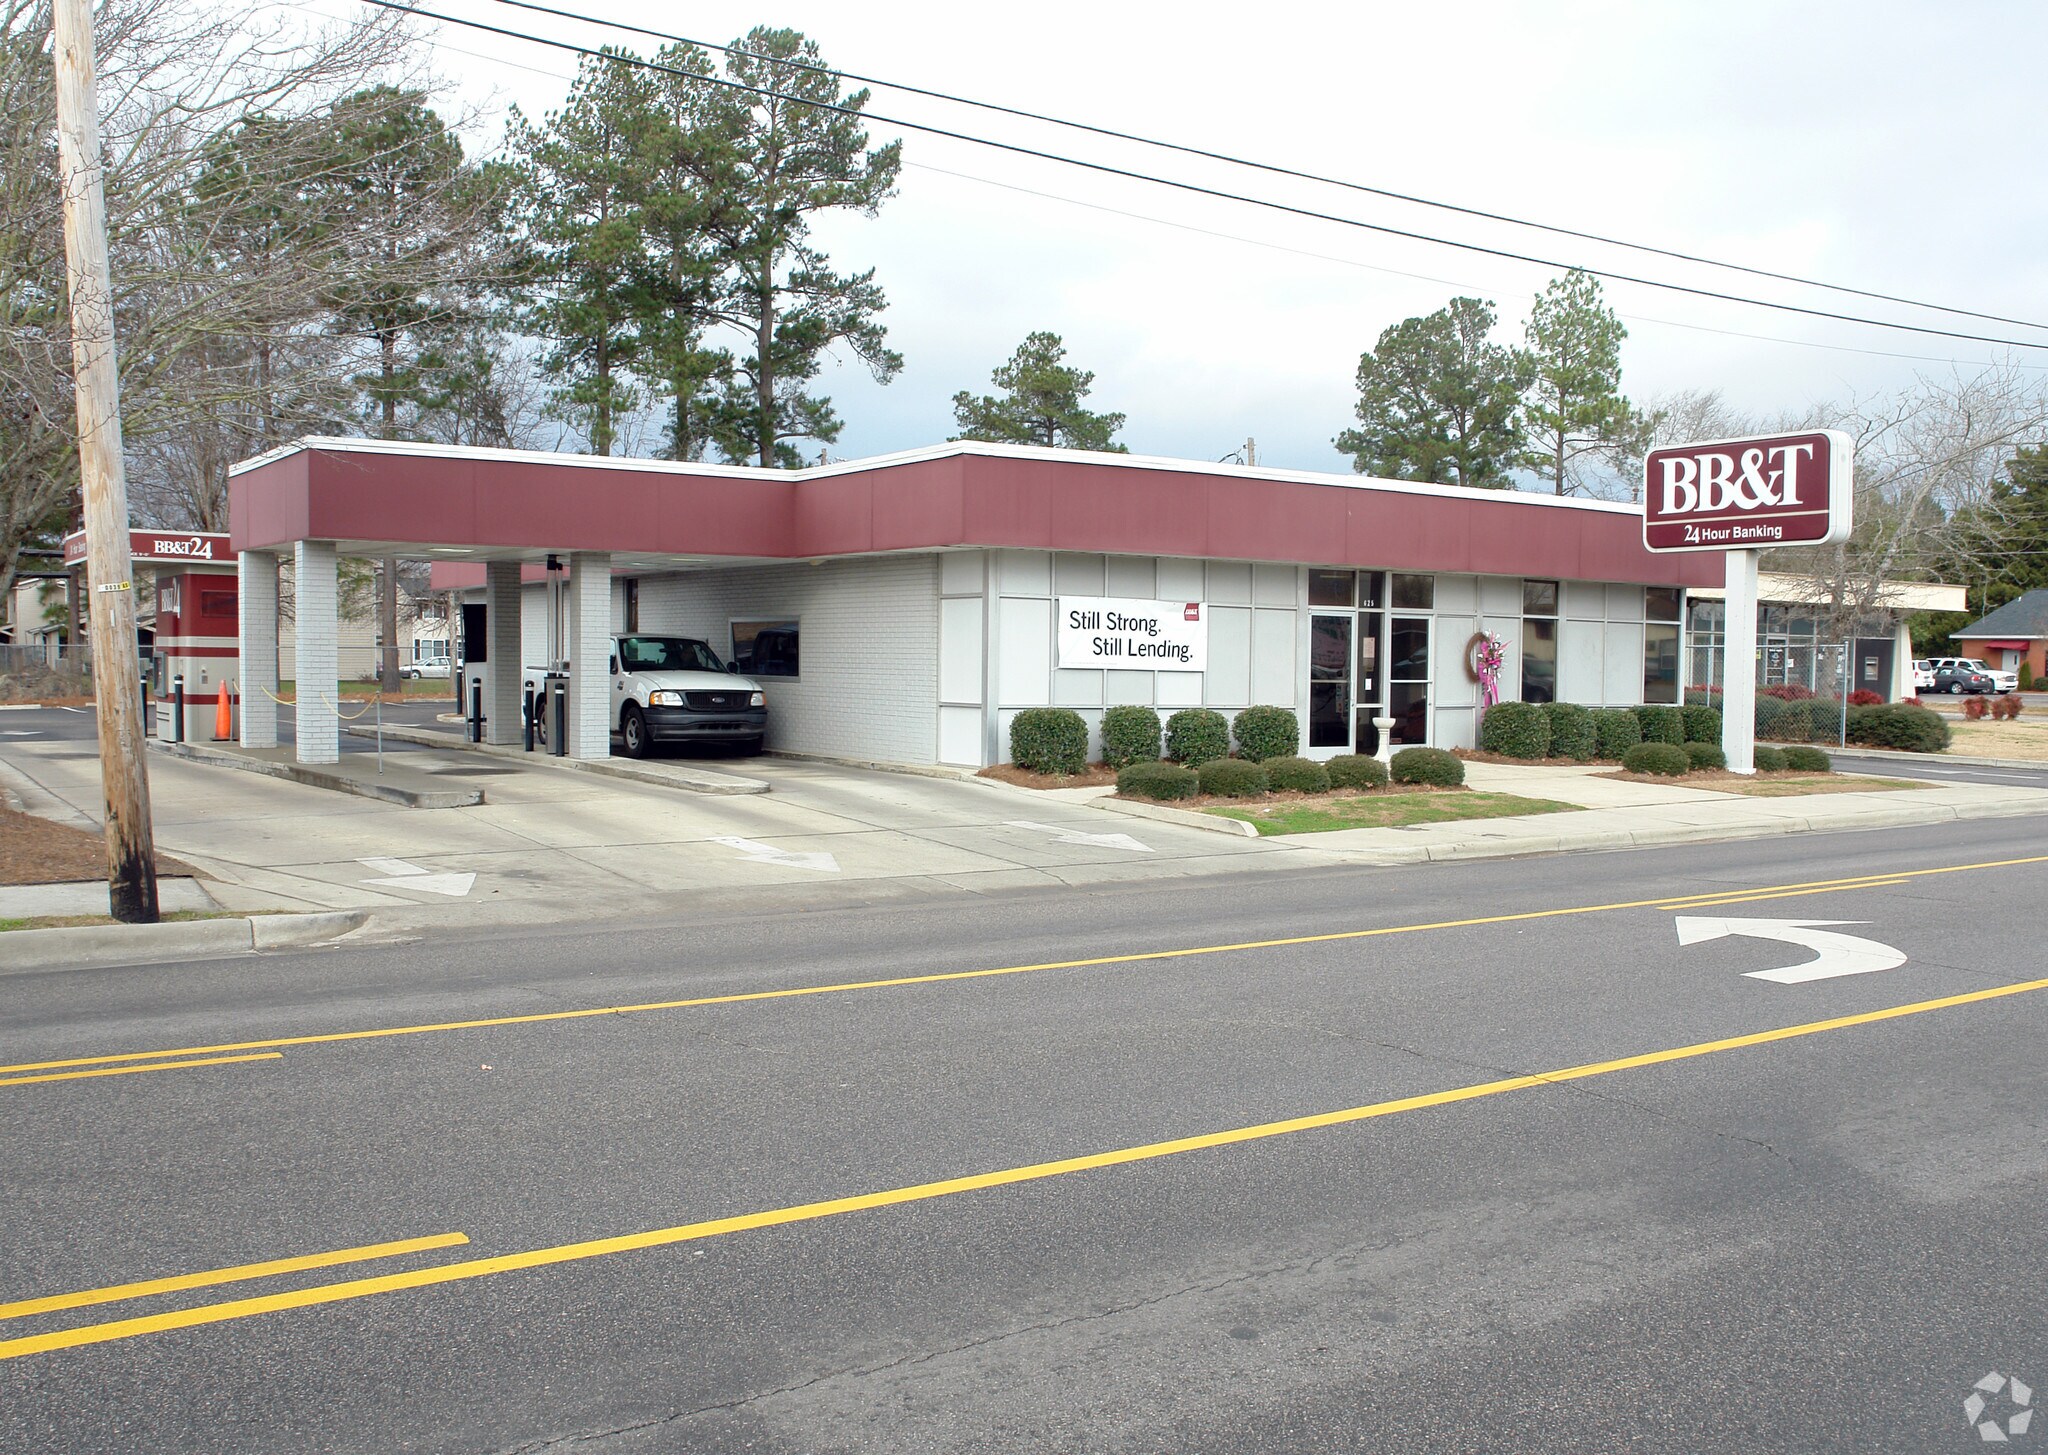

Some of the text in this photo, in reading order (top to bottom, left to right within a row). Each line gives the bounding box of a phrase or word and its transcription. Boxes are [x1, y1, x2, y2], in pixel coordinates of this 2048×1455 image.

[1657, 443, 1814, 515] BB&T
[1684, 524, 1783, 543] 24 Hour Banking
[1070, 610, 1161, 637] Still Strong.
[1093, 637, 1193, 663] Still Lending.
